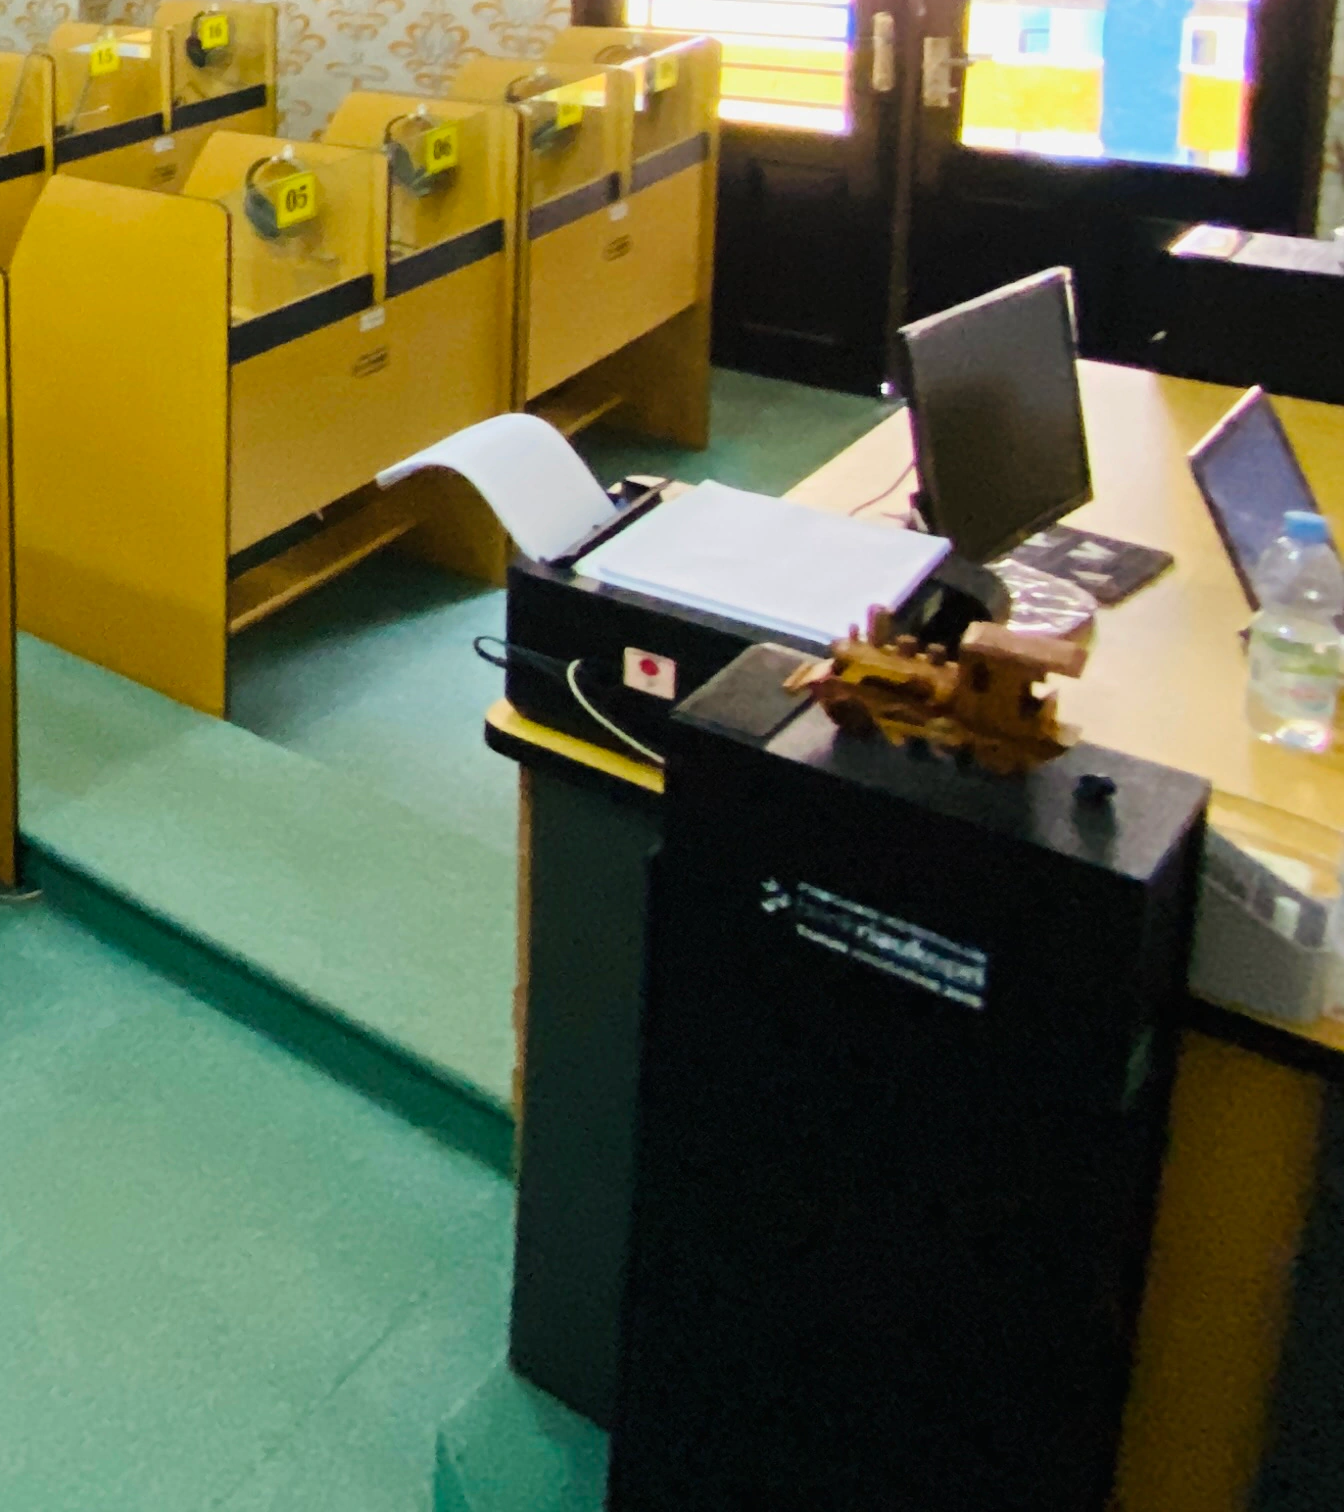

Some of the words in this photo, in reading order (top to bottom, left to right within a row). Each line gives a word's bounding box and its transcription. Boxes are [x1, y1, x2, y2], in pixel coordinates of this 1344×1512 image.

[209, 23, 222, 38] 16
[98, 49, 113, 64] 15
[286, 184, 308, 212] 05
